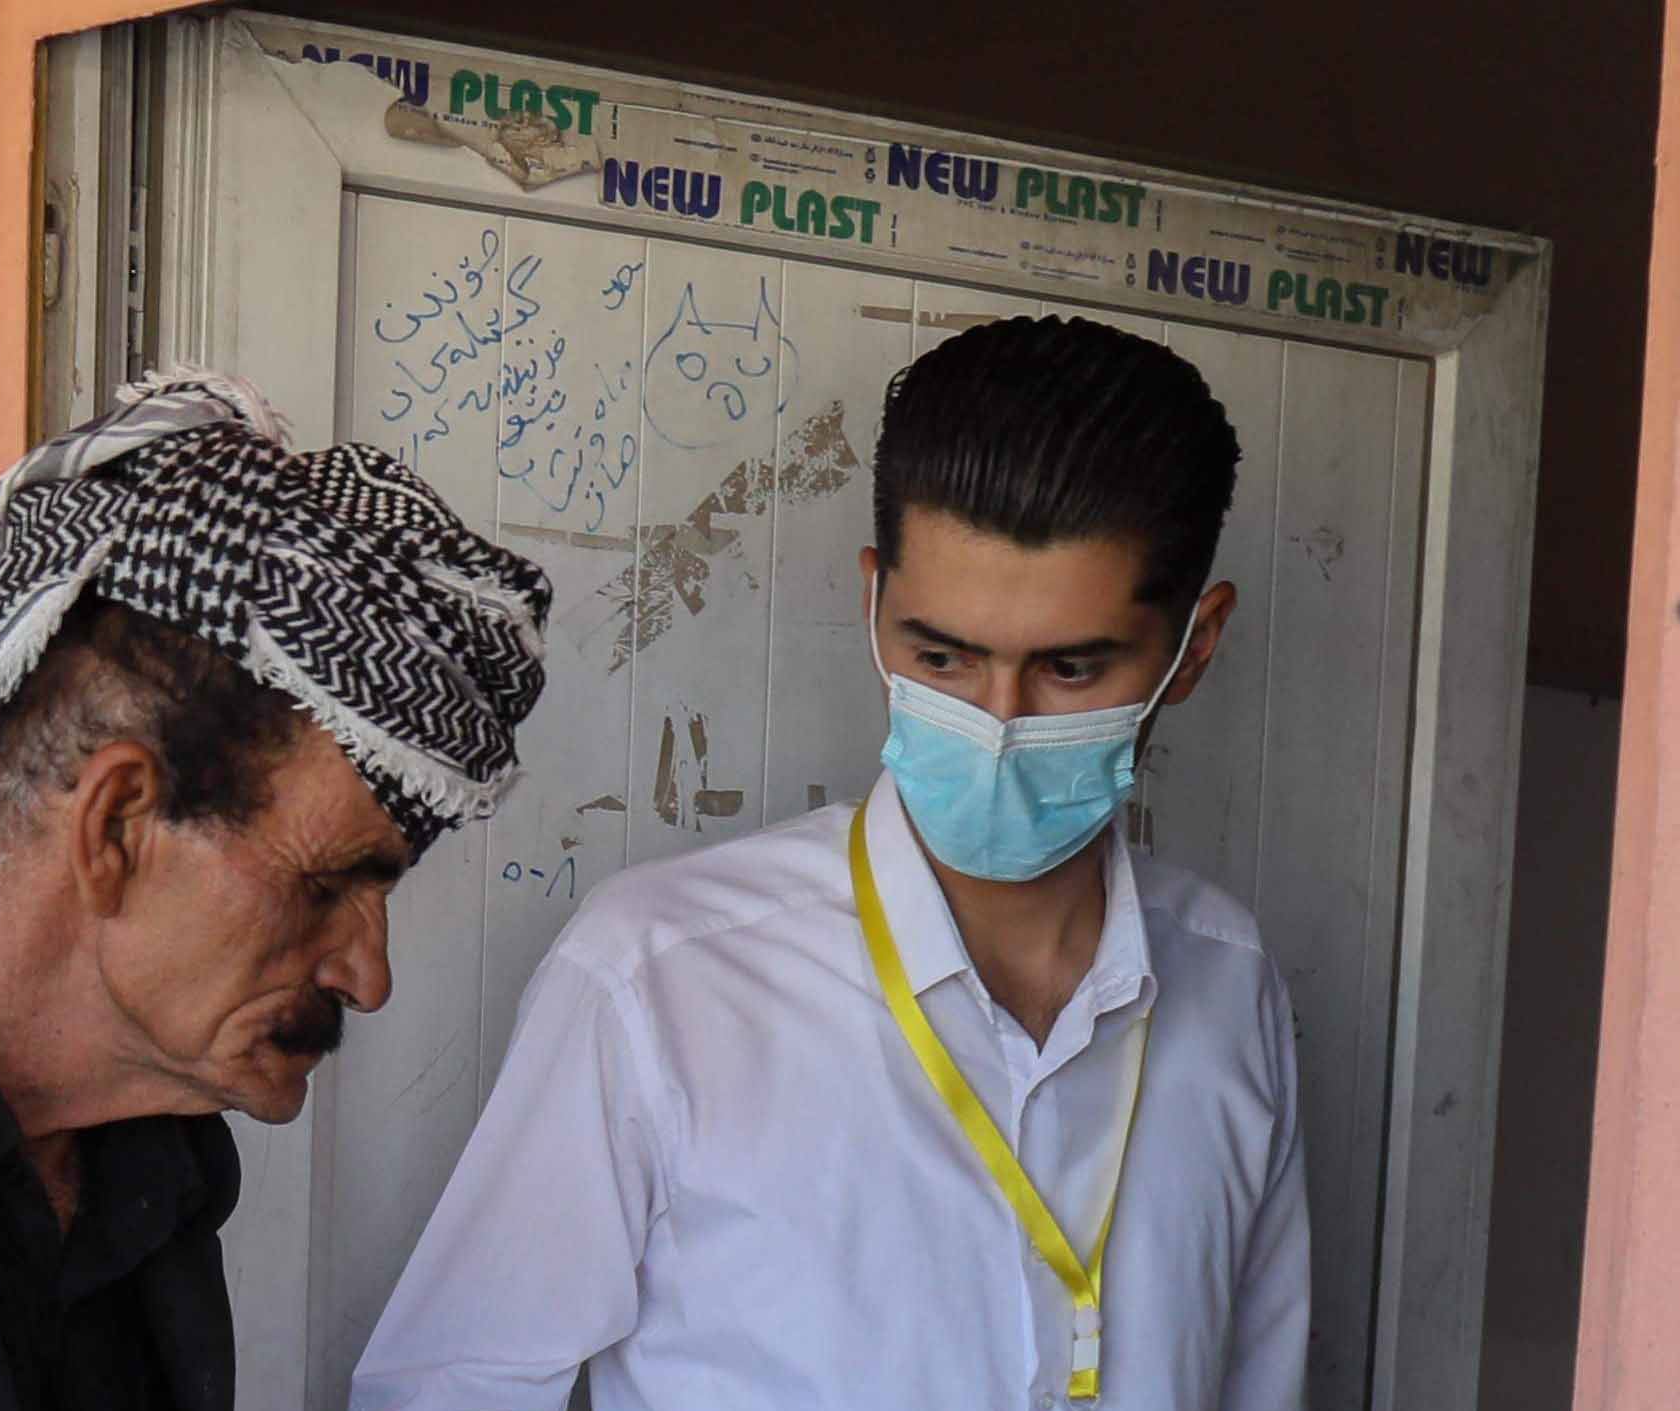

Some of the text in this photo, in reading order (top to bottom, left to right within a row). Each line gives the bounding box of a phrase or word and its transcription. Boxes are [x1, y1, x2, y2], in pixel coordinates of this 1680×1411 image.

[602, 157, 722, 219] NEW
[740, 180, 882, 244] PLAST
[887, 142, 999, 202] NEW
[1015, 167, 1147, 228] PLAST
[1146, 248, 1252, 305] NEW
[1267, 269, 1390, 328] PLAST
[1394, 230, 1495, 287] NEW
